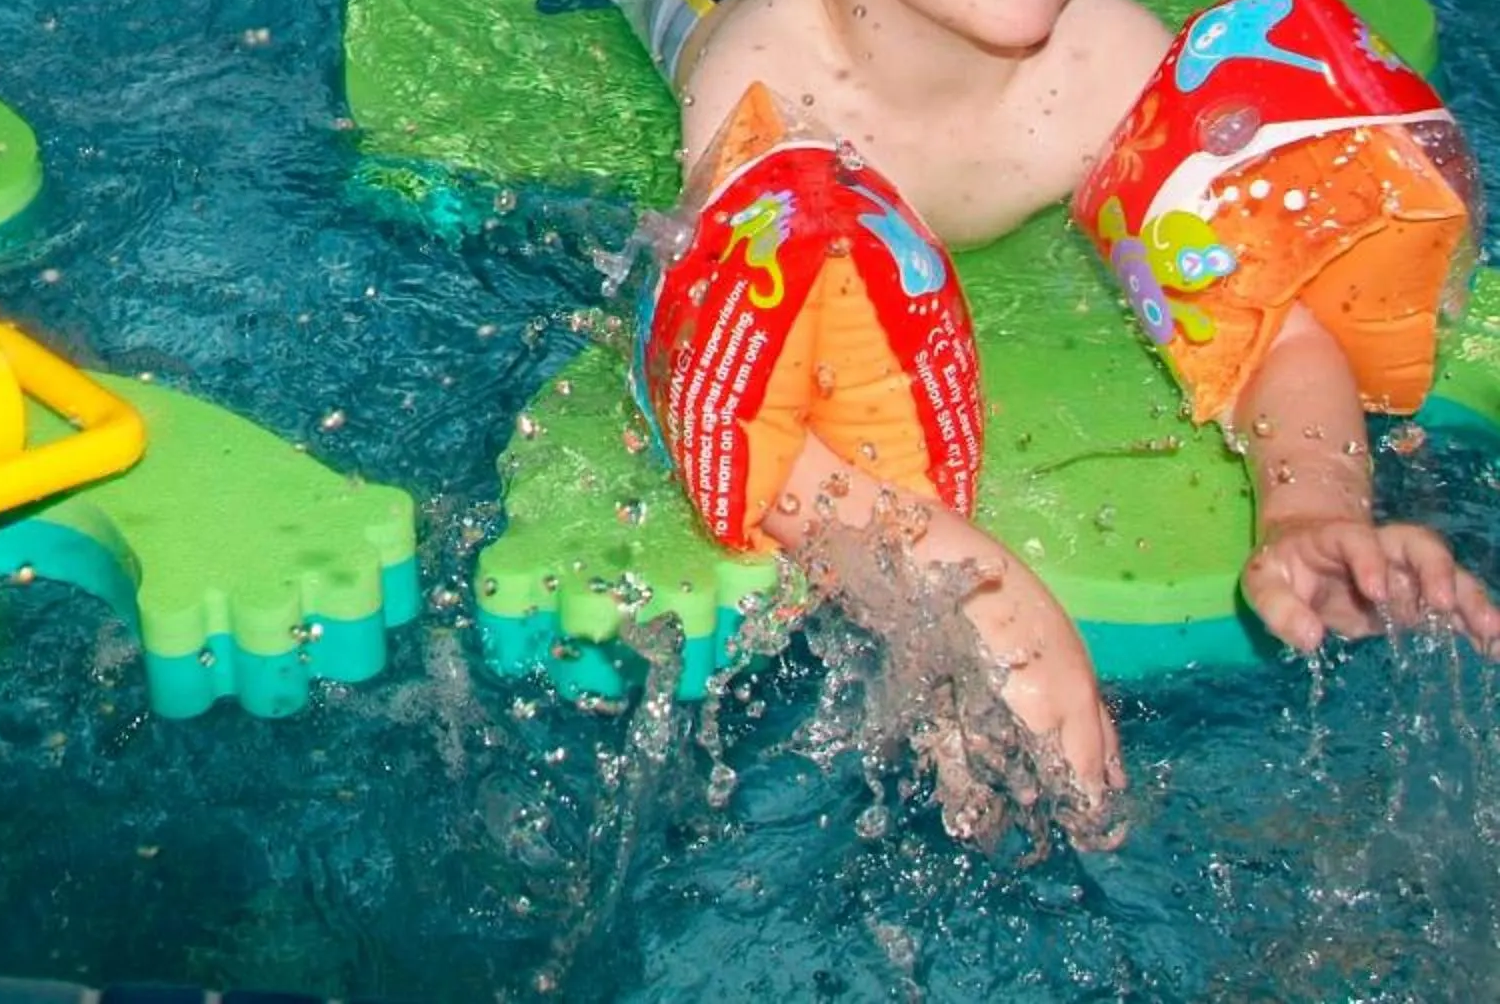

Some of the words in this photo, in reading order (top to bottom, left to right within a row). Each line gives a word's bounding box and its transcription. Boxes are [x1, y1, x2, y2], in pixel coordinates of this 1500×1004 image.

[733, 363, 752, 394] arm
[719, 393, 740, 426] uper
[720, 429, 733, 452] on
[698, 434, 713, 491] protect
[717, 454, 732, 494] worn
[714, 496, 729, 517] be
